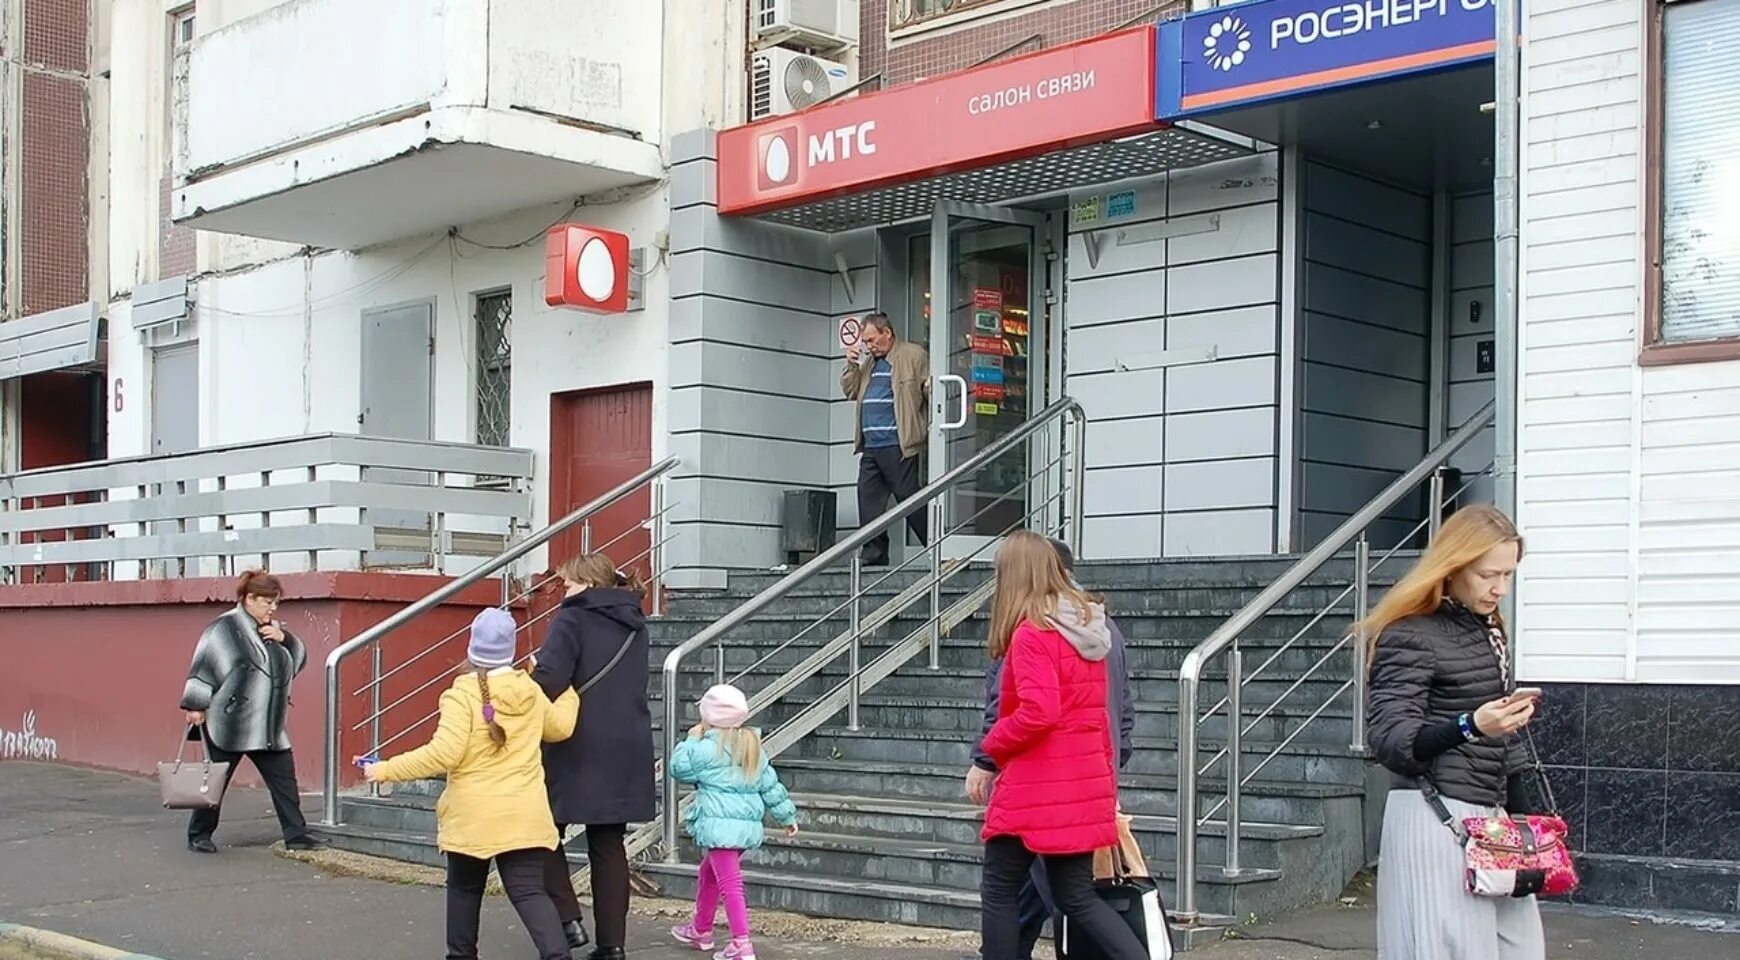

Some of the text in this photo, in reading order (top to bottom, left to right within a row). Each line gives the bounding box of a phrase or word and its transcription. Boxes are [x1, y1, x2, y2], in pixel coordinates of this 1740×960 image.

[1271, 0, 1496, 49] РОСЭНЕР
[968, 69, 1095, 115] салон связи
[807, 120, 876, 167] МТС
[114, 377, 123, 412] 6
